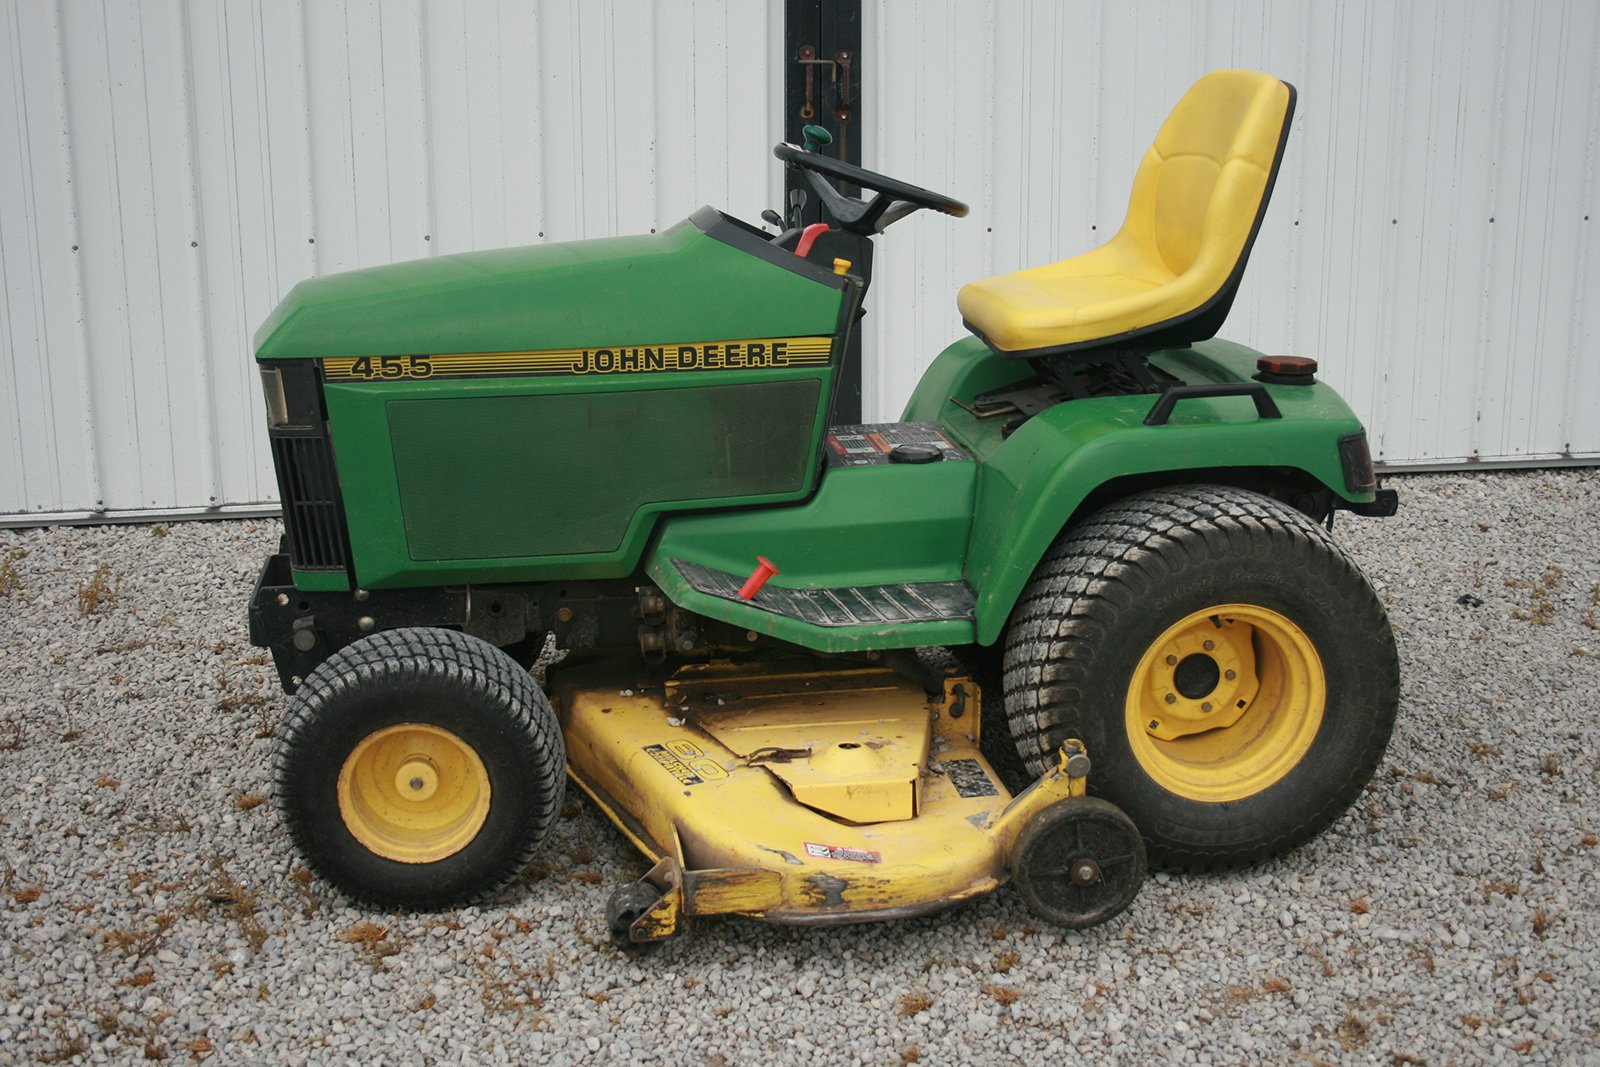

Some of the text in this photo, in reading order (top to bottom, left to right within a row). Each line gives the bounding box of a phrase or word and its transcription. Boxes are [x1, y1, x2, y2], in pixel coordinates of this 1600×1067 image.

[351, 356, 434, 379] 455
[572, 342, 789, 374] JOHN DEERE
[665, 739, 730, 780] 60
